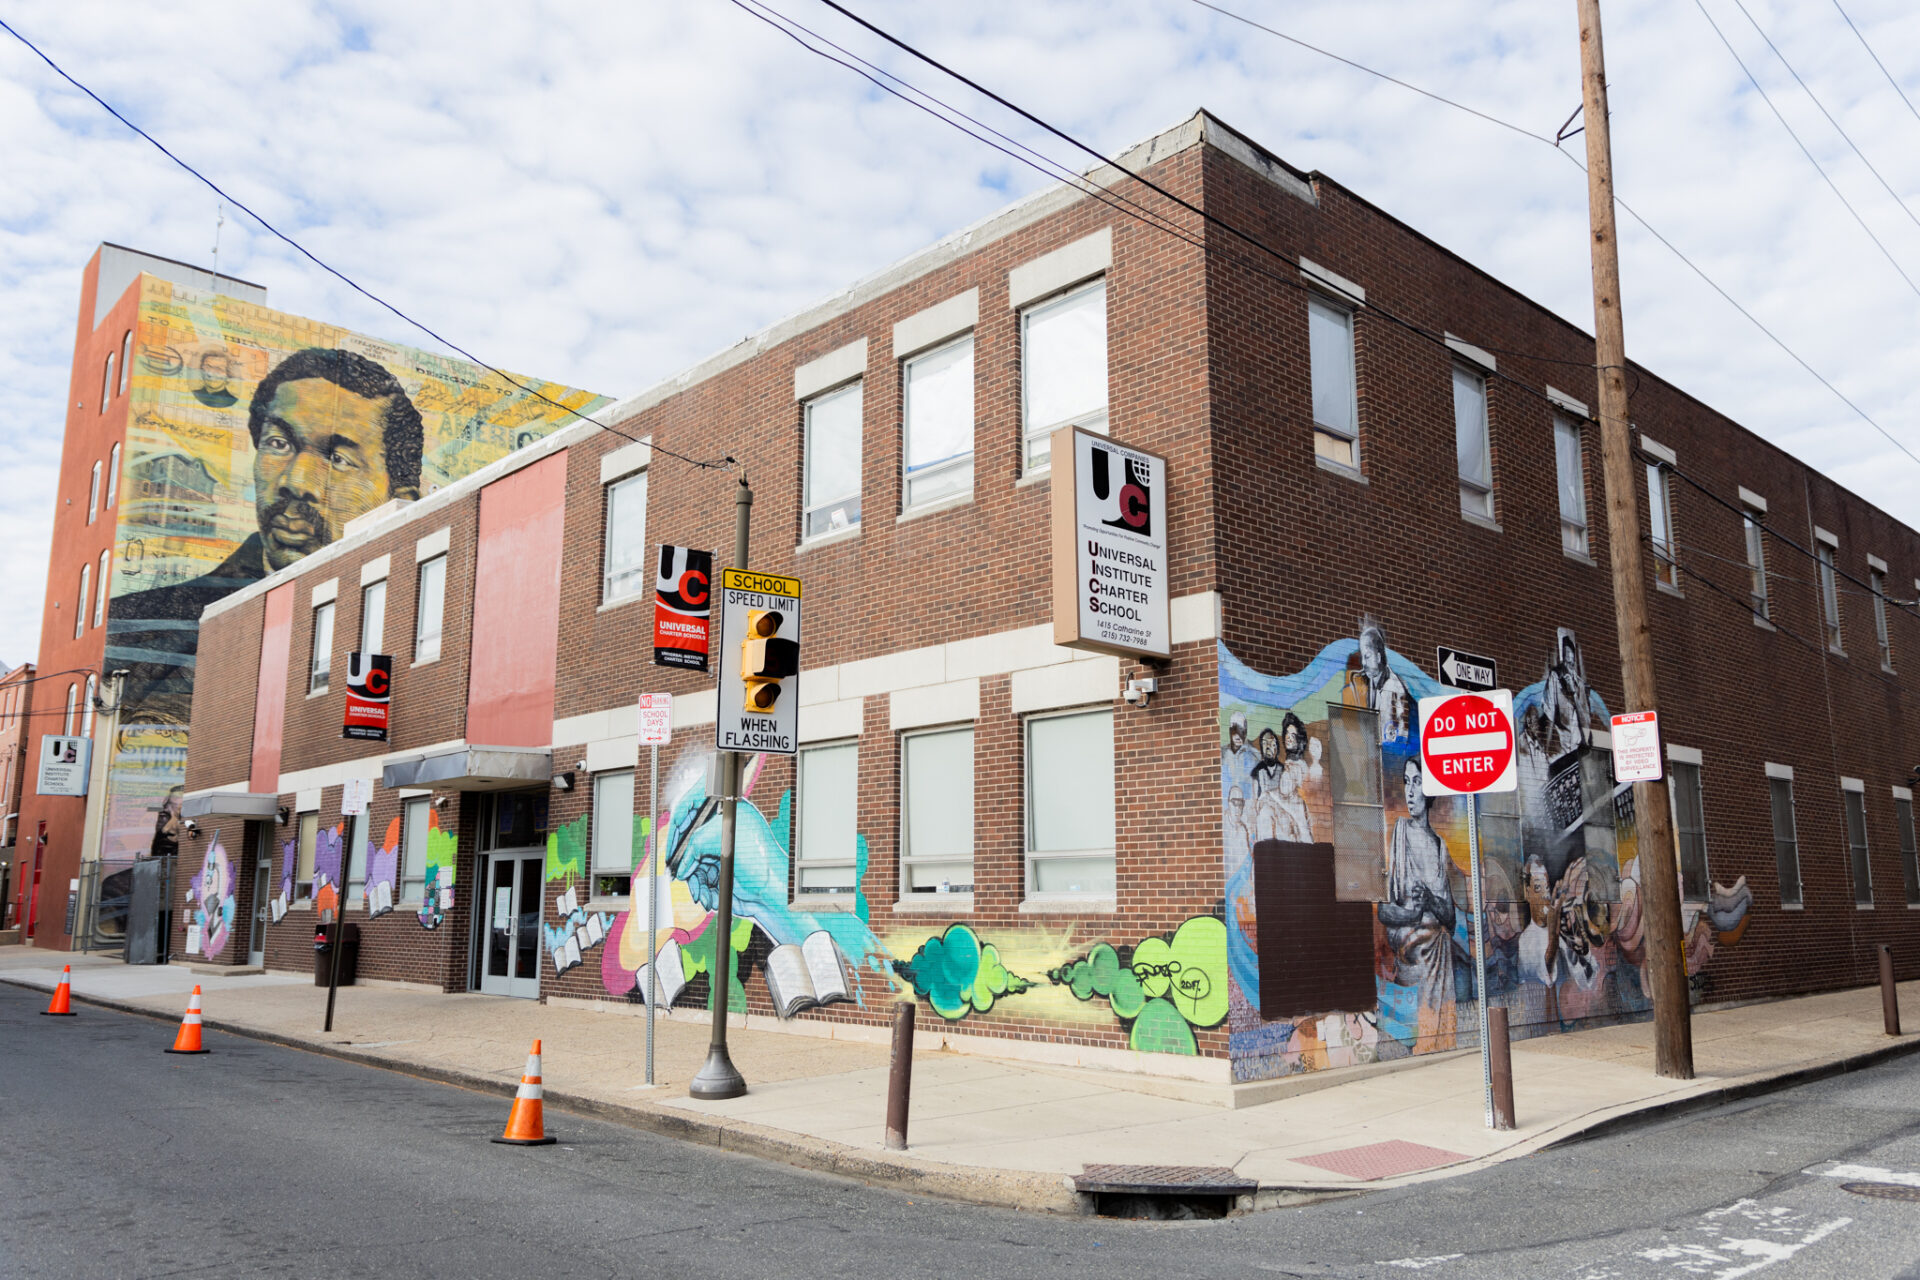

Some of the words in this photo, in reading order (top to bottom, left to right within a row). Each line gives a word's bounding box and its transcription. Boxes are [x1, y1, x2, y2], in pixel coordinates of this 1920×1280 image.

[1092, 441, 1119, 455] UNIVERSAL
[733, 574, 792, 595] SCHOOL
[729, 591, 764, 608] SPEED
[769, 596, 795, 612] LIMIT
[660, 620, 706, 635] UNIVERSAL
[660, 629, 682, 637] CHARTER
[1097, 620, 1111, 630] 1415
[1113, 624, 1144, 637] Catharine
[1101, 630, 1118, 640] (215)
[1456, 663, 1472, 680] ONE
[1474, 667, 1490, 684] WAY
[641, 696, 651, 707] NO
[350, 705, 385, 715] UNIVERSAL
[643, 710, 668, 719] SCHOOL
[647, 719, 664, 727] DAYS
[741, 717, 777, 733] WHEN
[1434, 716, 1455, 733] DO
[1466, 711, 1497, 730] NOT
[725, 731, 790, 749] FLASHING
[1442, 756, 1494, 775] ENTER
